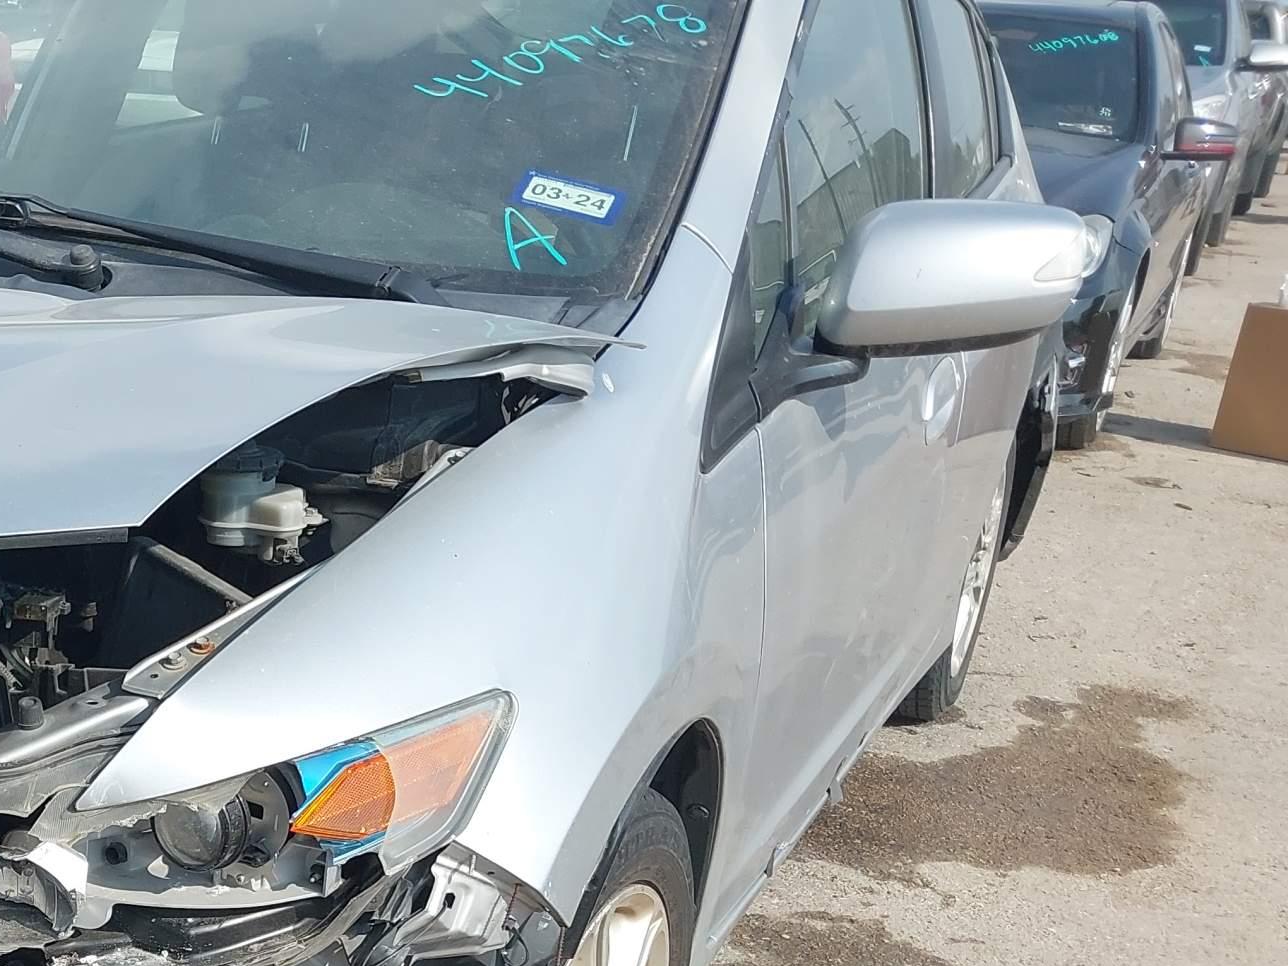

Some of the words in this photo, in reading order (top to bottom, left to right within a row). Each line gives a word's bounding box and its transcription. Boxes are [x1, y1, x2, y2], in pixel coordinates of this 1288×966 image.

[414, 4, 707, 97] 44097678
[530, 183, 562, 200] 03
[573, 193, 606, 211] 24
[504, 207, 568, 271] A
